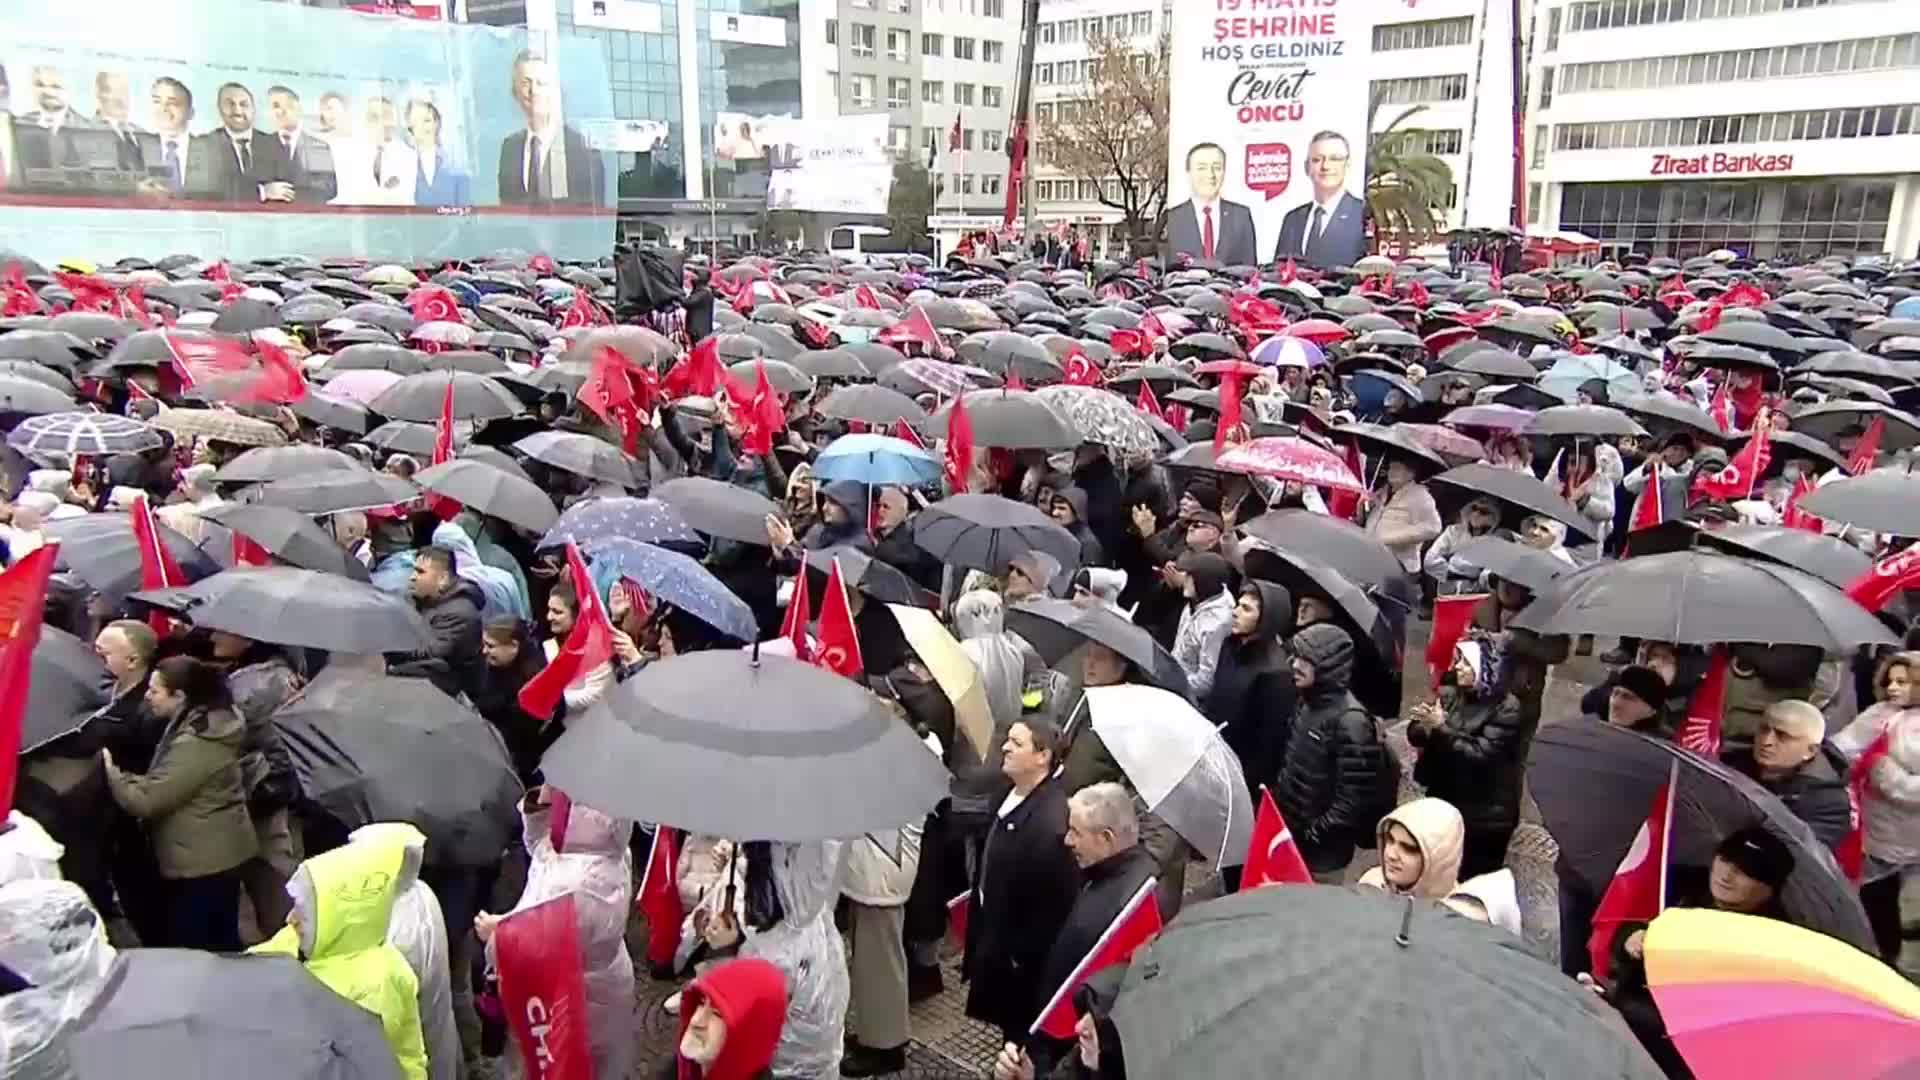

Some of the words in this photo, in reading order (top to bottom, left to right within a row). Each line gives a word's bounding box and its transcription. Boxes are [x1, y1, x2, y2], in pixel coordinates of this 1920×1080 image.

[1214, 12, 1336, 42] ŞEHRİNE
[1202, 44, 1244, 62] HOŞ
[1250, 38, 1344, 60] GELDİNİZ
[1227, 69, 1316, 106] Cevat
[1237, 100, 1304, 124] ÖNCÜ
[1650, 154, 1709, 174] Ziraat
[1712, 152, 1793, 172] Bankası
